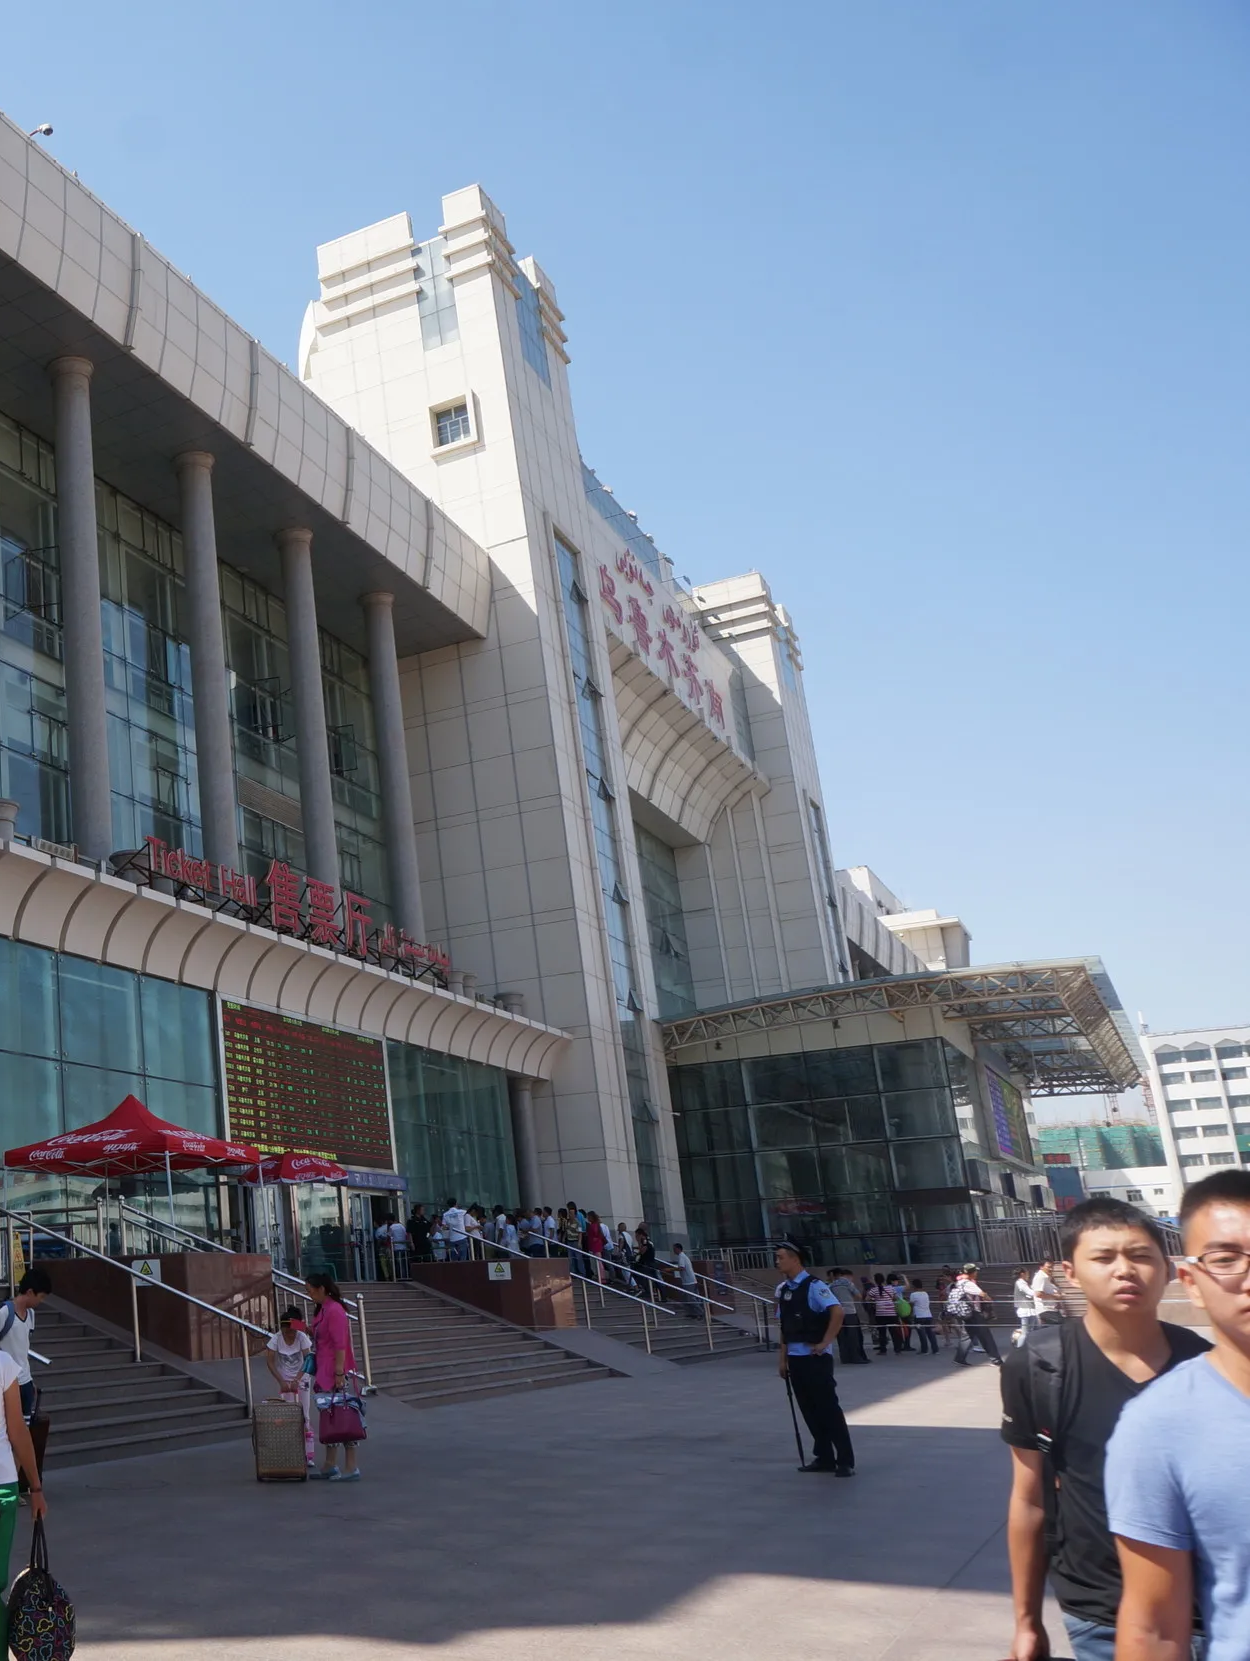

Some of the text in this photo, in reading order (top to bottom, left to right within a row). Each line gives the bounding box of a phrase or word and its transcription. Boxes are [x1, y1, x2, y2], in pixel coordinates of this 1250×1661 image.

[145, 836, 258, 908] Ticket Hall
[265, 858, 372, 957] 售票厅
